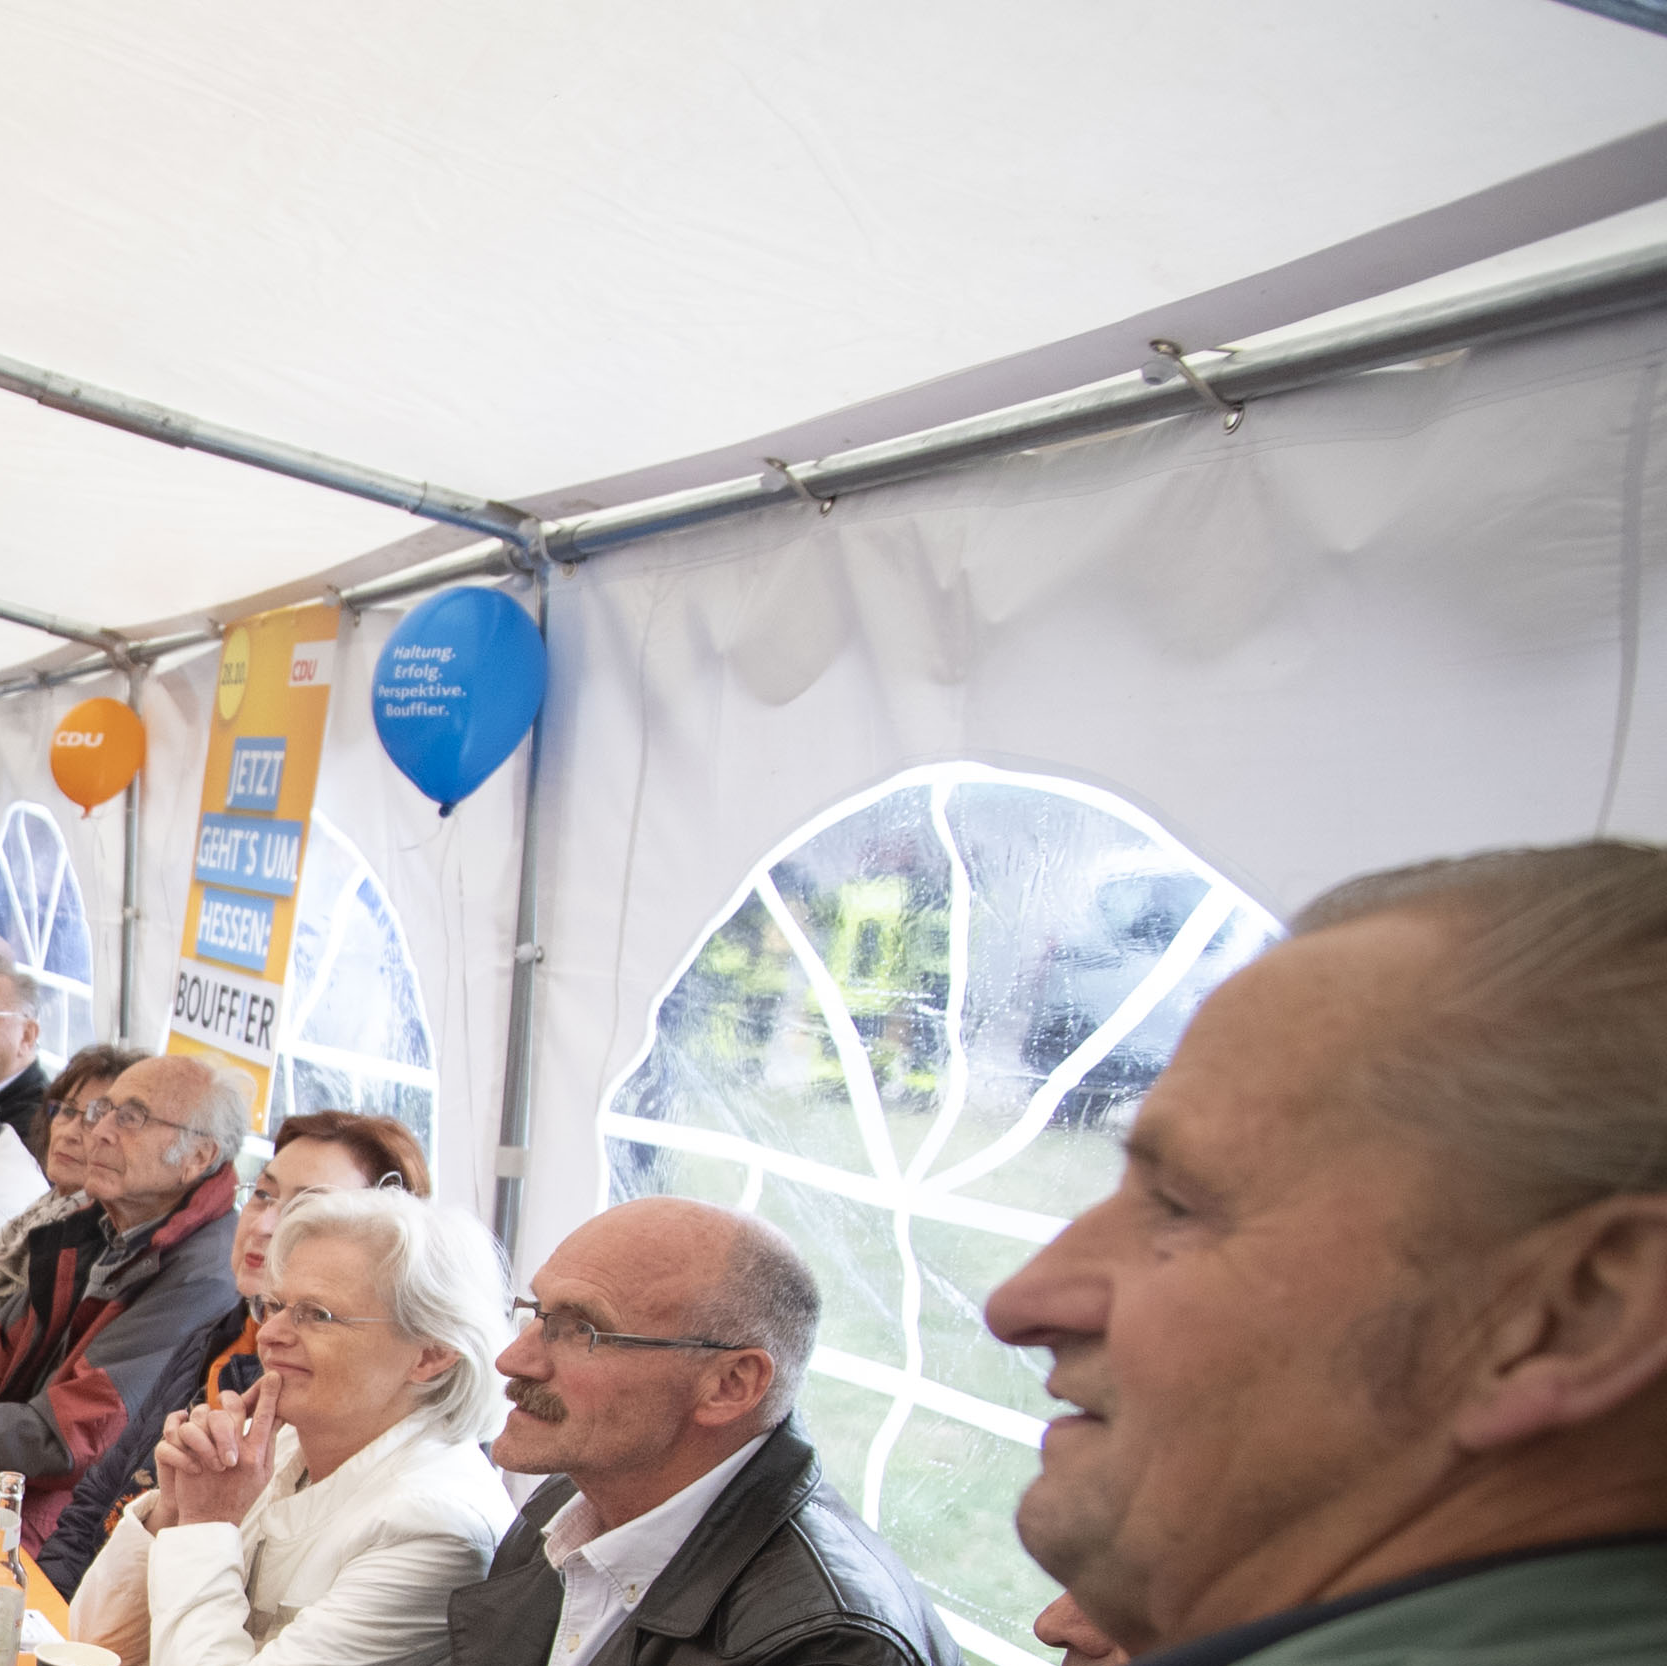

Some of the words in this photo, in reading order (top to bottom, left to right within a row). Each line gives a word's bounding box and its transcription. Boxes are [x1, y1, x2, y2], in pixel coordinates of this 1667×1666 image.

[393, 645, 457, 662] Haltung.
[291, 658, 318, 682] CDU
[394, 664, 443, 682] Erfolg.
[378, 683, 467, 701] Perspektive.
[385, 701, 451, 718] Bouffier.
[55, 730, 105, 748] CDU
[226, 749, 285, 807] JETZT
[198, 899, 270, 958] HESSEN:
